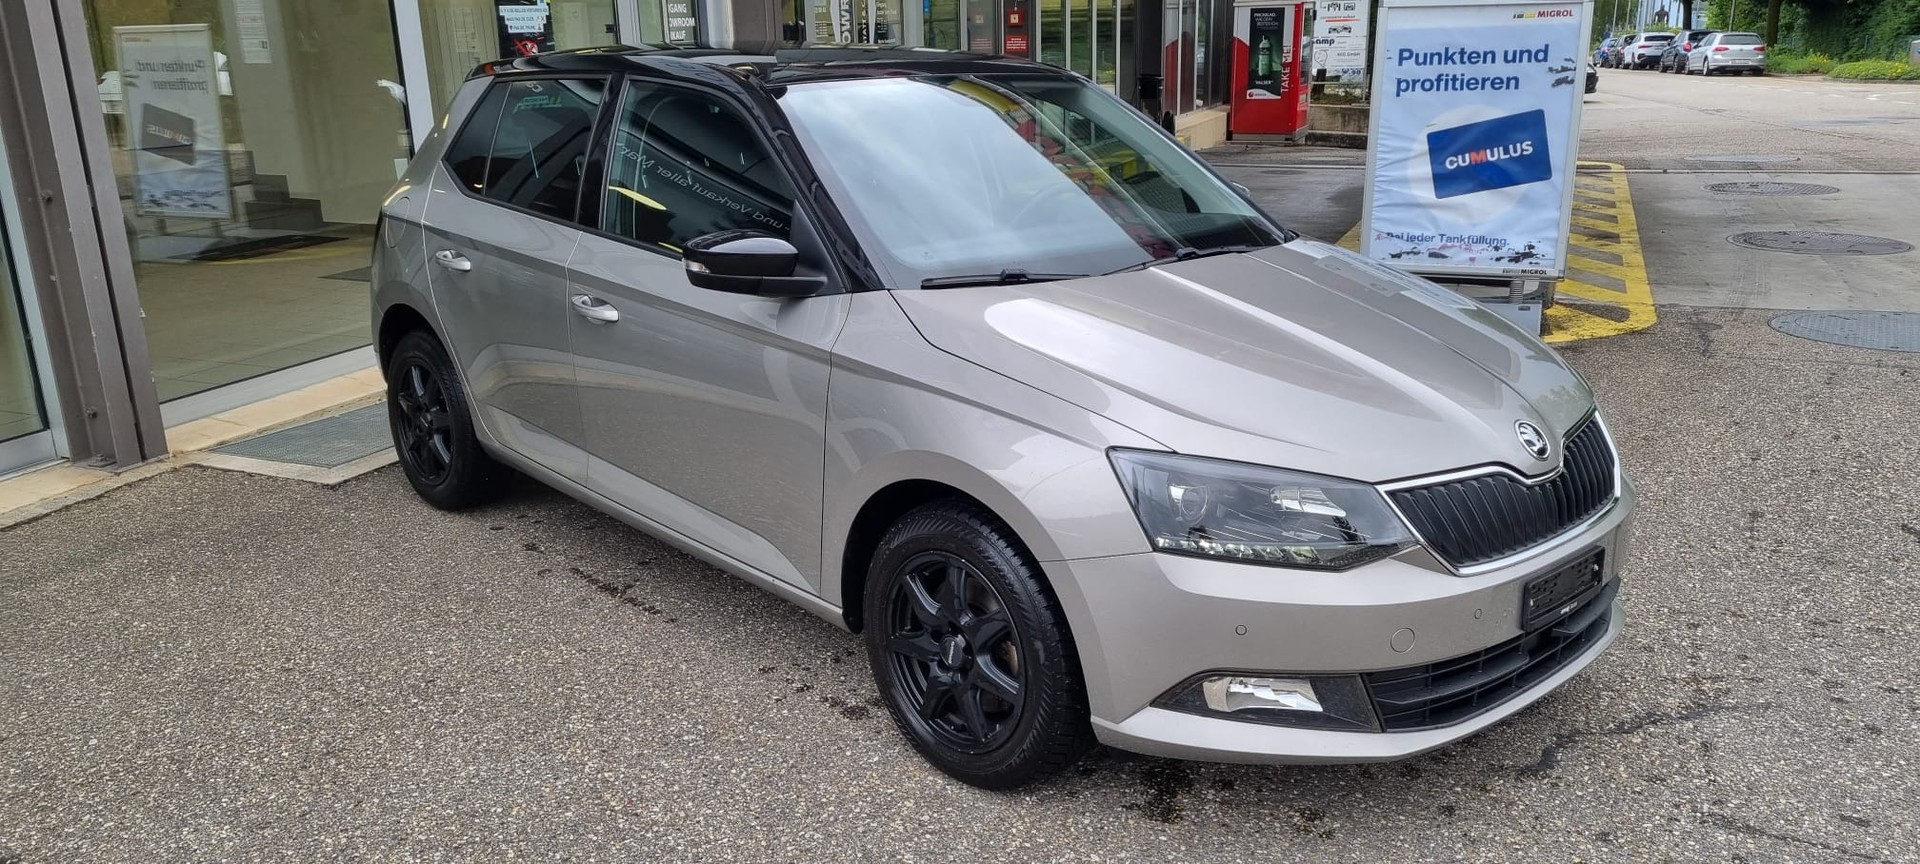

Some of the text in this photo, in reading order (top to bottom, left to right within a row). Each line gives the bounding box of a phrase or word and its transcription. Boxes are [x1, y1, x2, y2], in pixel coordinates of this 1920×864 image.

[1537, 9, 1574, 18] MIGROL
[1398, 44, 1549, 67] Punkten und
[1281, 44, 1292, 92] TAKE ME!
[1395, 73, 1520, 97] profitieren
[1445, 140, 1534, 169] CUMULUS
[1438, 233, 1510, 247] Tankfüllung.
